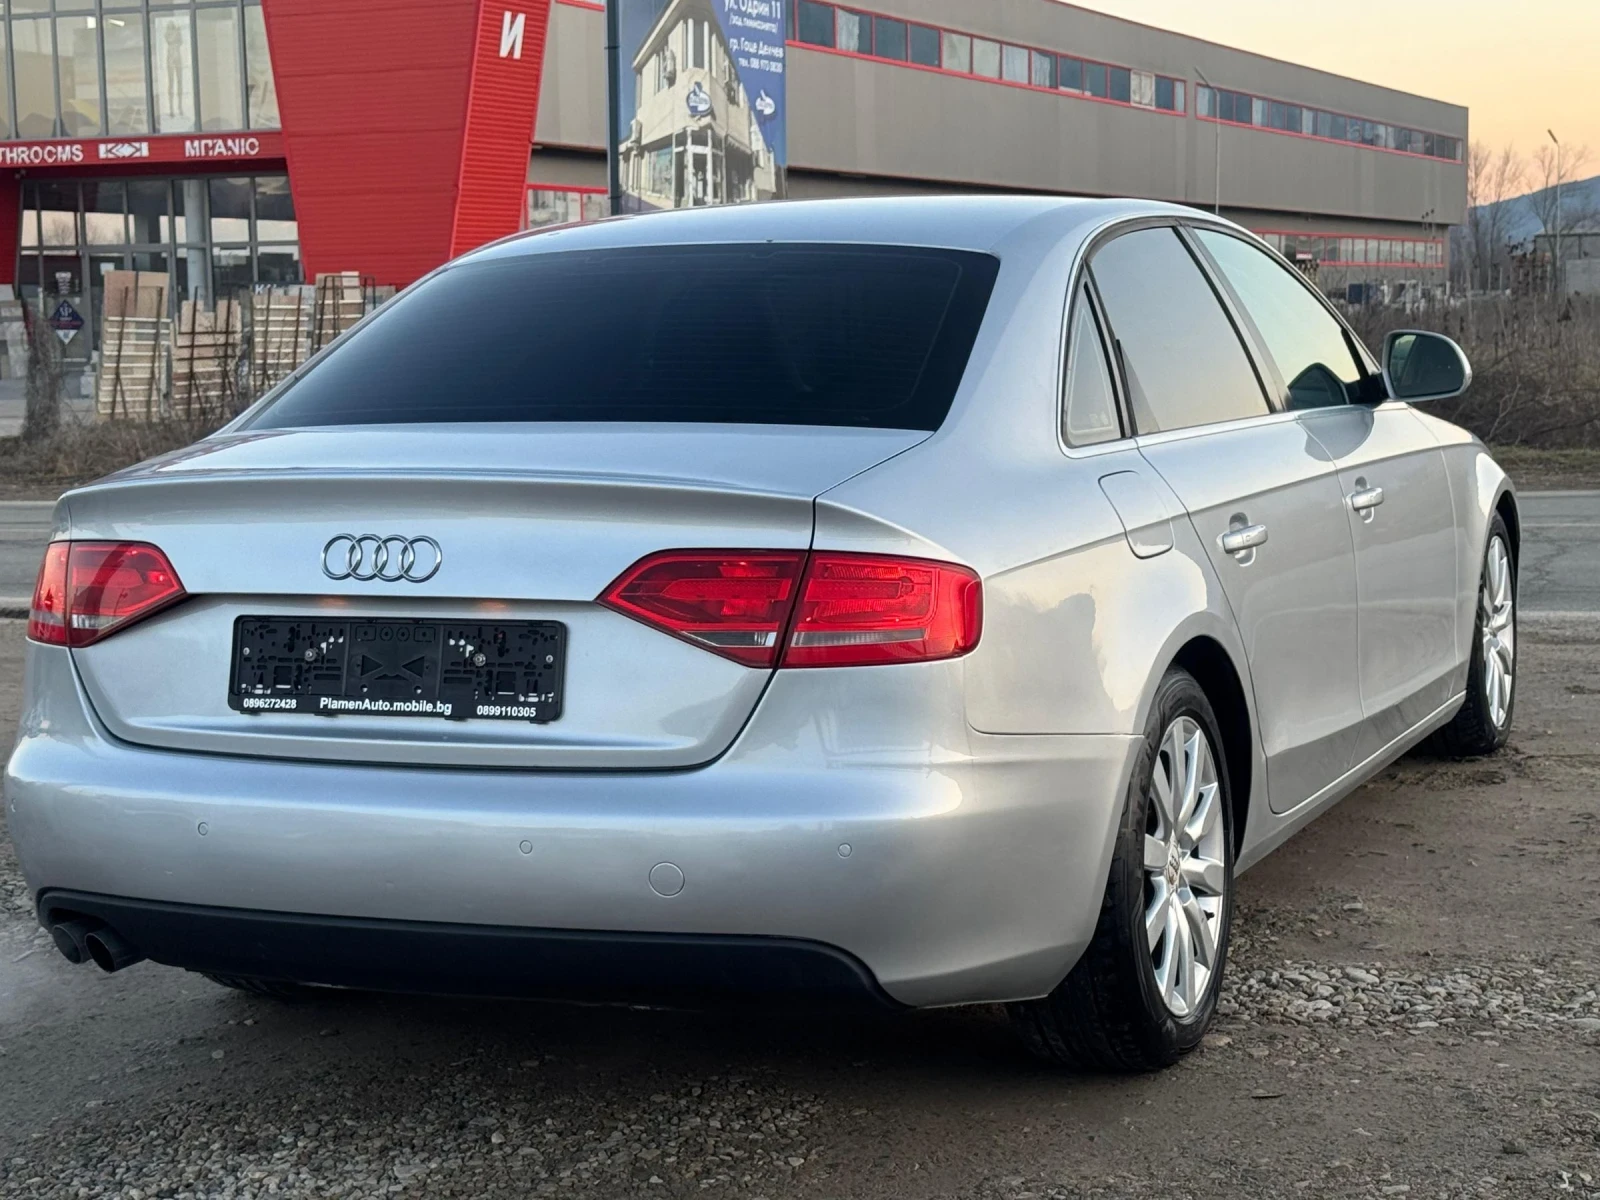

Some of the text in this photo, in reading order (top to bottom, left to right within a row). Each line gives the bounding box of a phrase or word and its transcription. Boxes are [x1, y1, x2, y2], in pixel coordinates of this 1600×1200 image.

[771, 1, 781, 19] 11
[243, 698, 297, 709] 0896272428
[320, 697, 452, 715] PlamenAuto.mobile.bg
[476, 705, 536, 717] 0899110305
